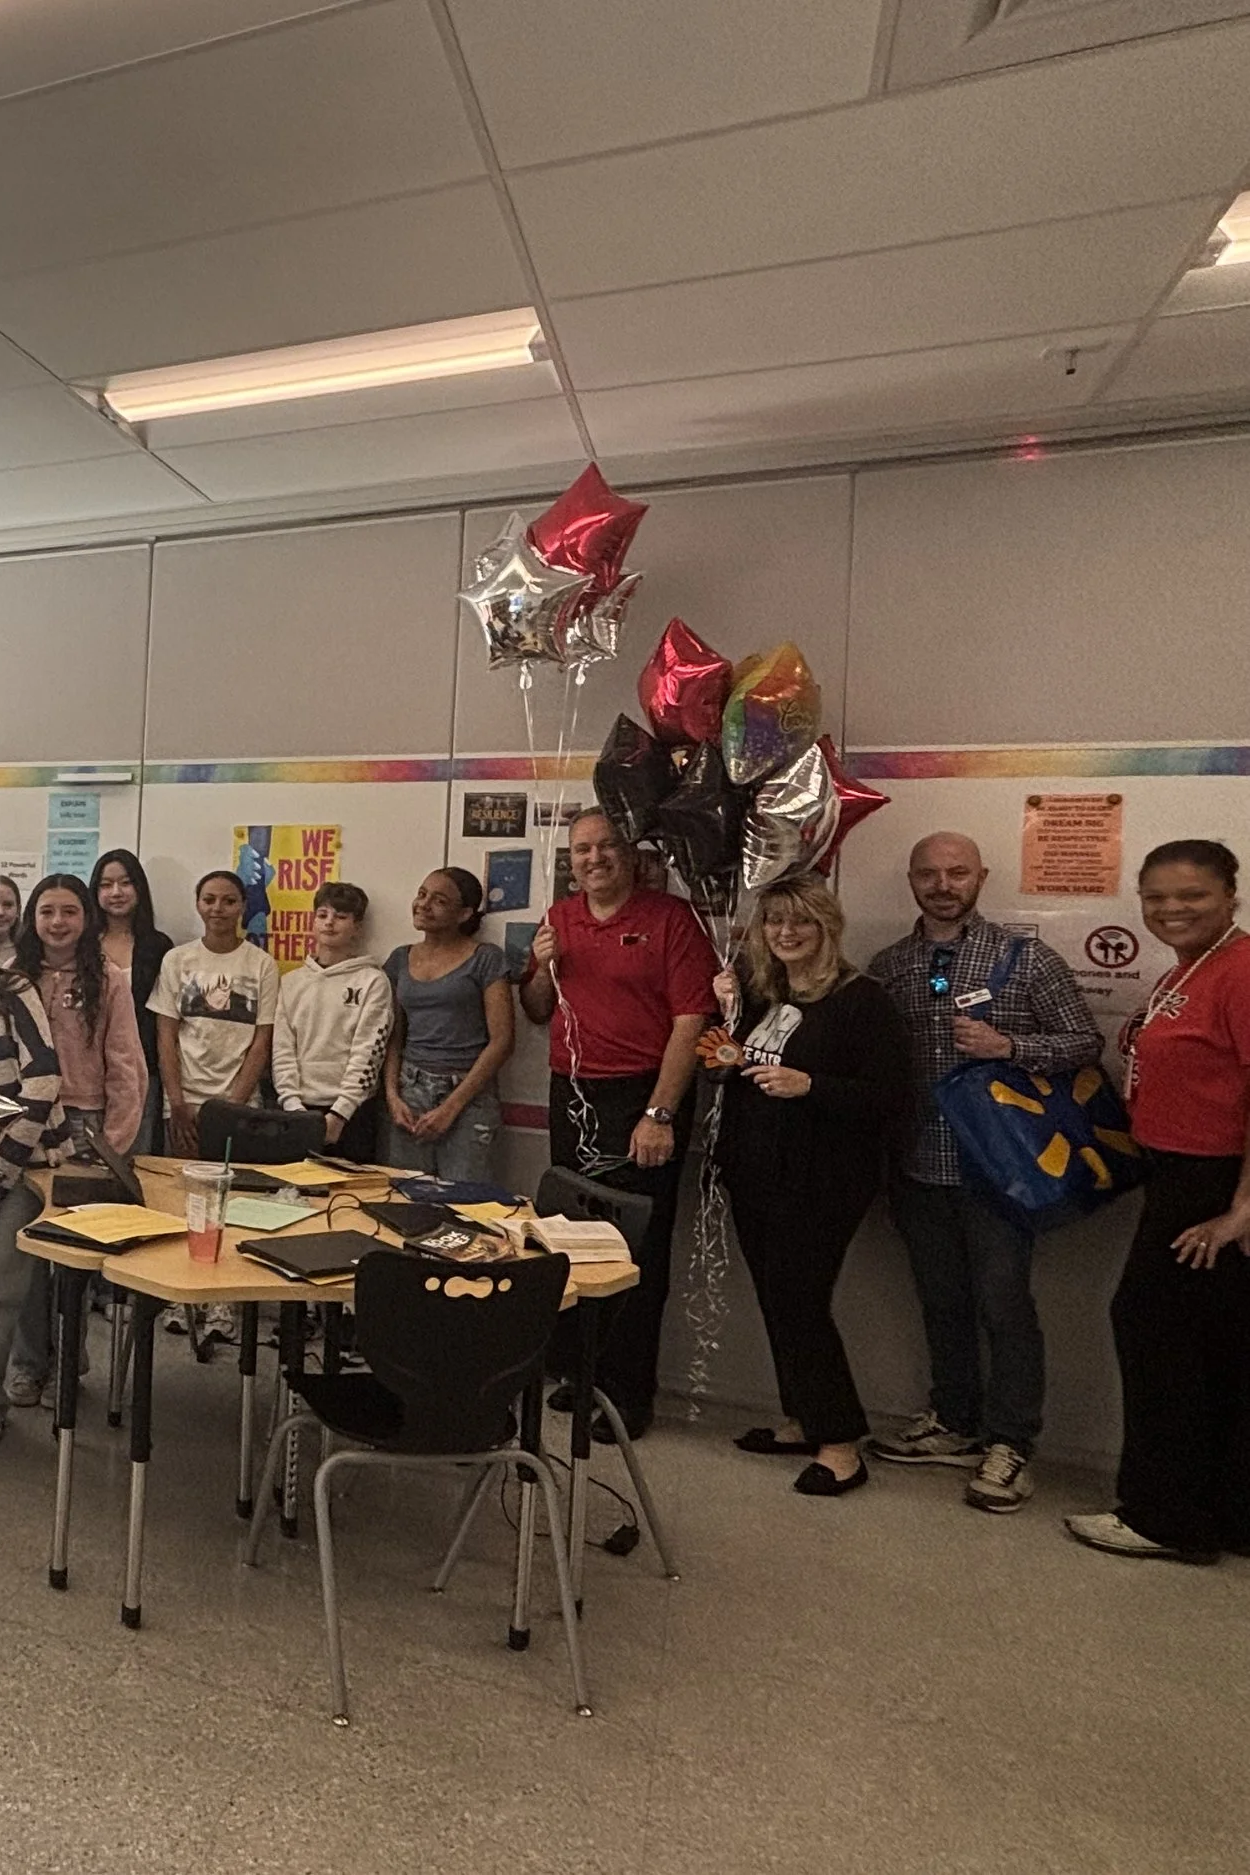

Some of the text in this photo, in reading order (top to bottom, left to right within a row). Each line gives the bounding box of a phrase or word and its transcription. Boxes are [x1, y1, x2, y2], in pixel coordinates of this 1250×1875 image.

[302, 829, 336, 857] WE
[1115, 970, 1140, 979] and
[420, 1231, 463, 1247] BOOK
